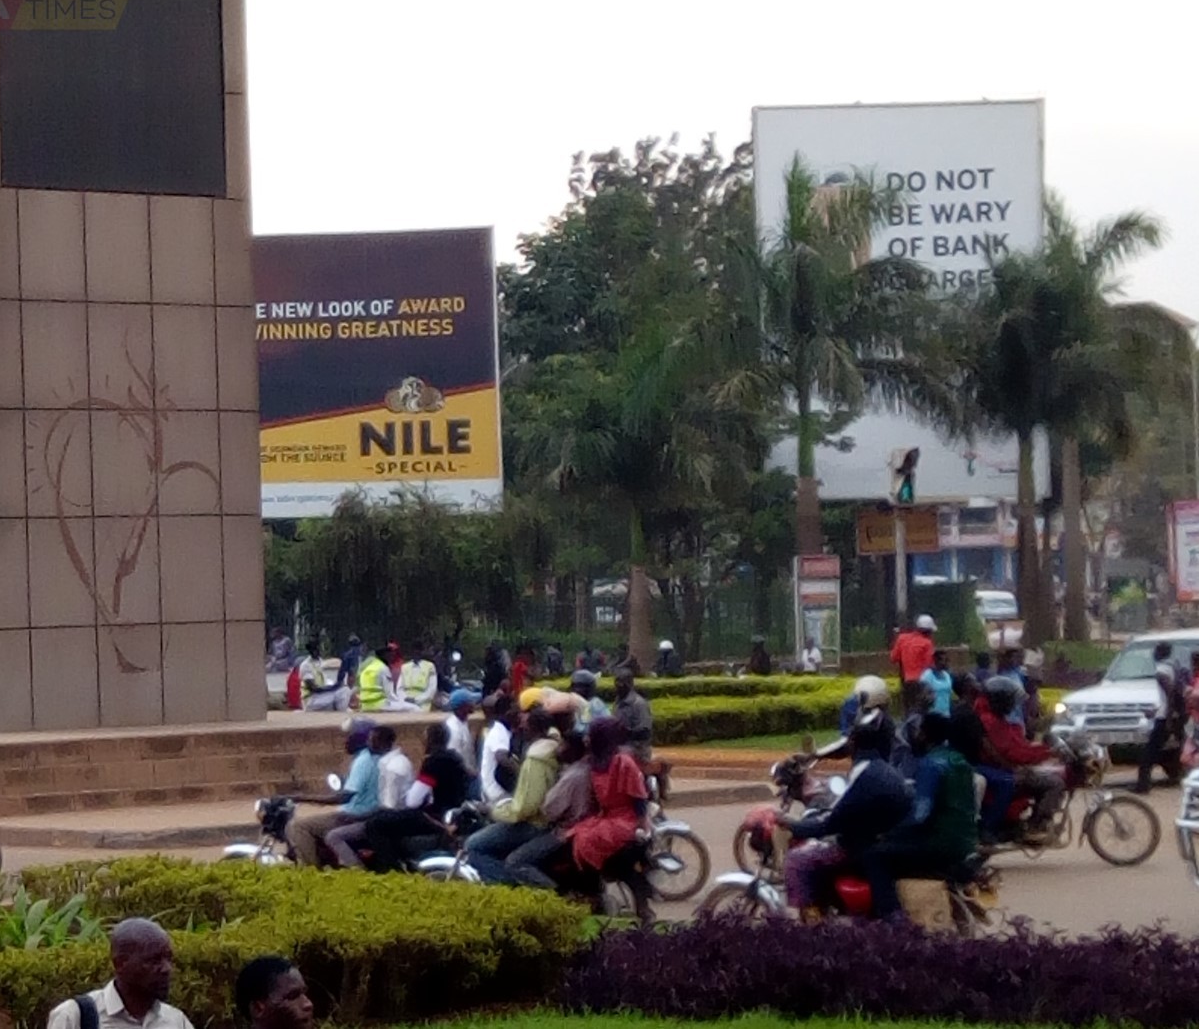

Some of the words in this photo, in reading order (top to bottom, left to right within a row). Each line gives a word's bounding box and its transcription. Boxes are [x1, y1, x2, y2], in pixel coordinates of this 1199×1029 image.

[886, 171, 927, 193] DO
[935, 168, 995, 191] NOT
[887, 204, 923, 227] BE
[930, 201, 1013, 224] WARY
[887, 236, 925, 258] OF
[933, 233, 1010, 257] BANK
[271, 301, 313, 319] NEW
[317, 299, 366, 317] LOOK
[370, 299, 394, 316] OF
[397, 296, 465, 315] AWARD
[337, 318, 454, 339] GREATNESS
[359, 418, 471, 457] NILE
[374, 461, 458, 475] SPECIAL
